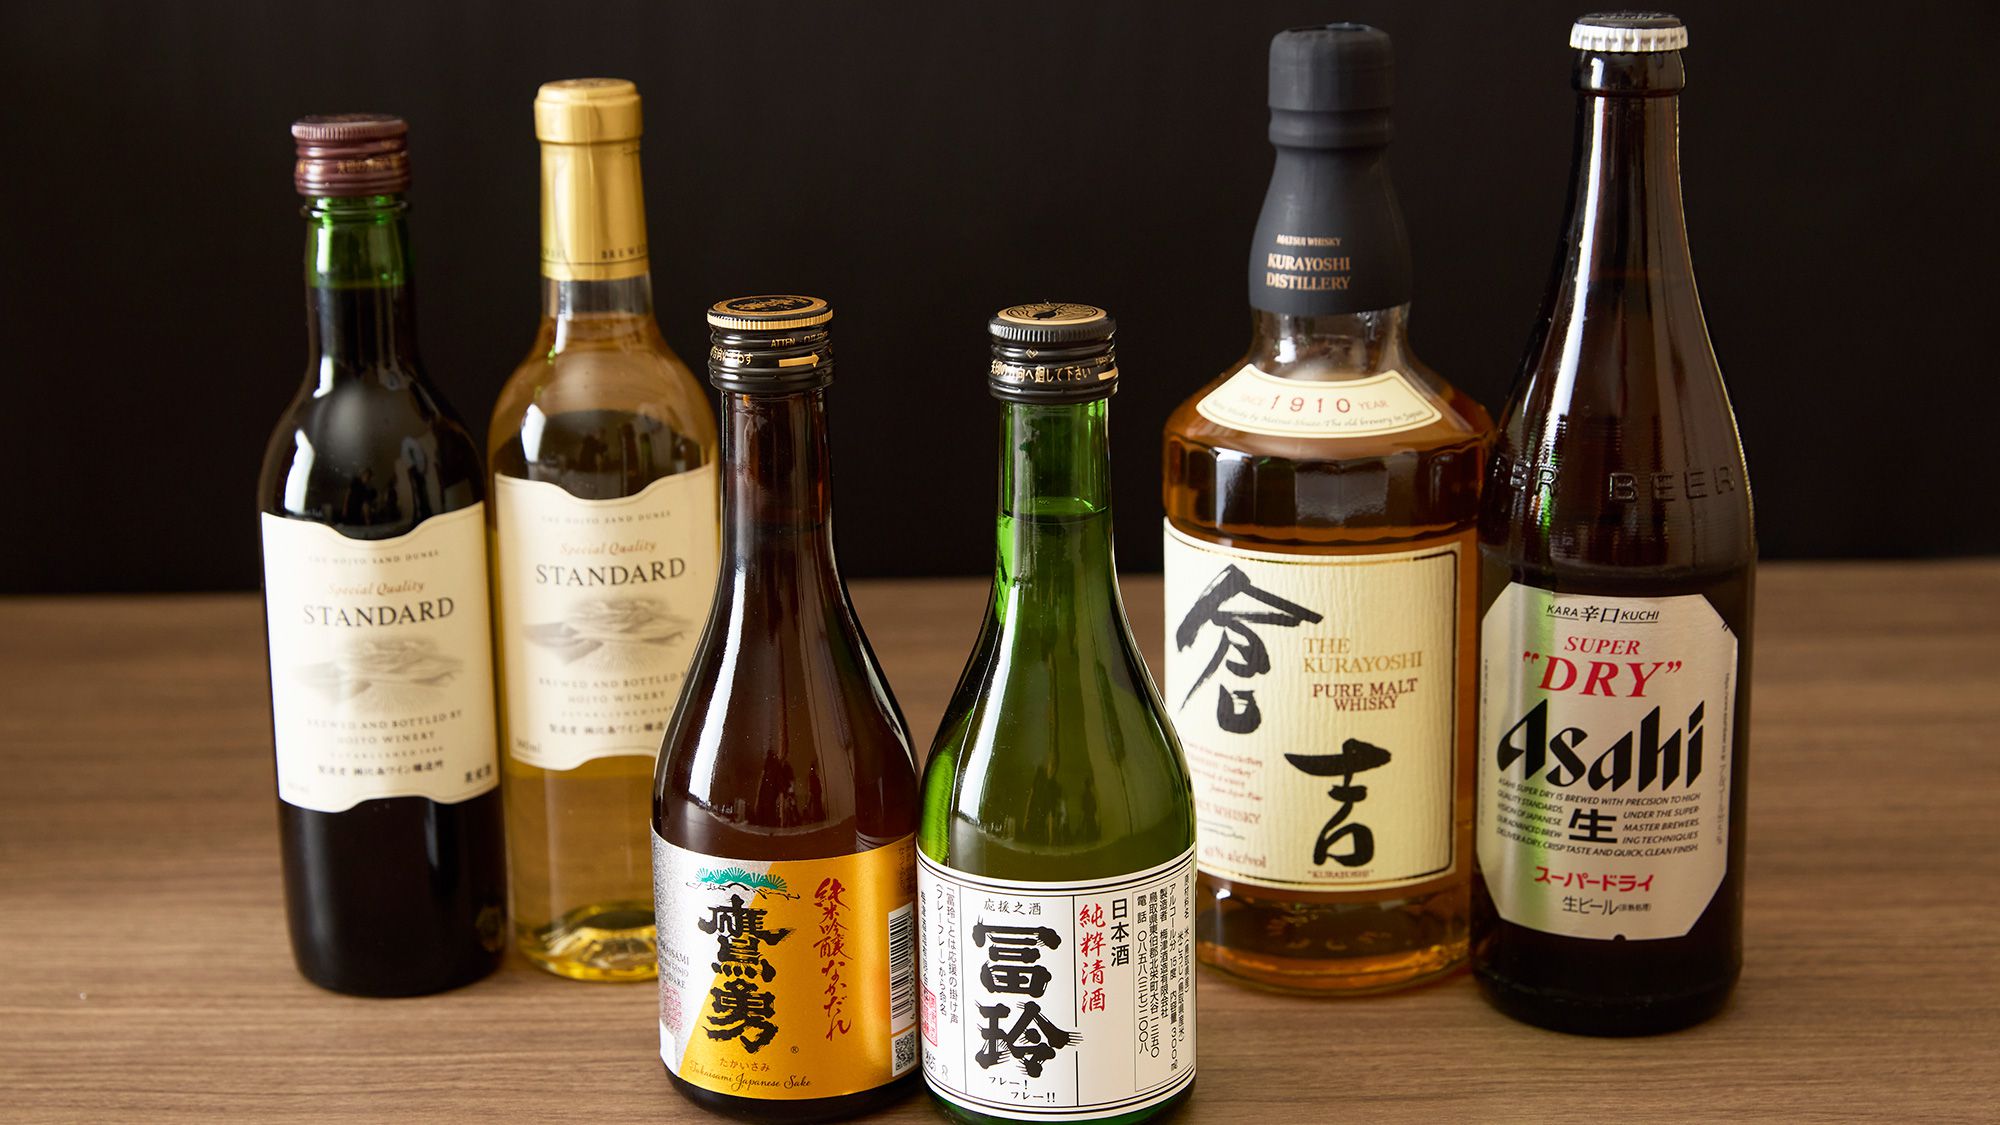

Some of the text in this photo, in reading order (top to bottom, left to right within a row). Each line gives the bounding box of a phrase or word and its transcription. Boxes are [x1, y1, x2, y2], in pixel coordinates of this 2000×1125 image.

[1307, 236, 1341, 247] WHISKY
[1267, 253, 1350, 272] KURAYOSHI
[1266, 272, 1351, 290] DISTILLERY
[1358, 400, 1389, 411] YEAR
[1609, 465, 1735, 501] BEER
[560, 539, 657, 556] Special Quality
[535, 557, 686, 586] STANDARD
[376, 579, 425, 597] Quality
[303, 597, 454, 627] STANDARD
[1546, 604, 1660, 623] KARA 辛口 KUCHI
[1303, 638, 1350, 654] THE
[1564, 636, 1641, 655] SUPER
[1304, 651, 1423, 673] KURAYOSHI
[592, 680, 618, 689] AND
[623, 671, 679, 687] BOTTLED
[1313, 678, 1418, 697] PURE MALT
[614, 690, 665, 703] WINERY
[1334, 694, 1399, 712] WHISKY
[361, 720, 388, 729] AND
[392, 711, 447, 728] BOTTLED
[449, 709, 462, 719] BY
[382, 730, 435, 744] WINERY
[1496, 698, 1705, 793] Asahi
[1517, 784, 1538, 795] SUPER
[1539, 789, 1555, 798] DRY
[1565, 794, 1599, 805] BREWED
[1601, 797, 1624, 806] WITH
[1626, 796, 1670, 806] PRECISION
[1671, 795, 1681, 803] TO
[1682, 792, 1701, 802] HIGH
[1526, 813, 1562, 826] JAPANESE
[1623, 811, 1654, 819] UNDER
[1656, 809, 1673, 818] THE
[1568, 808, 1618, 844] 生
[1623, 823, 1660, 832] MASTER
[1623, 830, 1699, 844] ING TECHNIQUES
[1543, 841, 1565, 851] CRISP
[1566, 845, 1592, 856] TASTE
[1593, 848, 1613, 856] AND
[1645, 847, 1672, 857] CLEAN
[1535, 865, 1654, 892] スーパードライ
[984, 898, 1042, 916] 応援之酒
[1562, 895, 1619, 915] 生ビール
[1111, 897, 1130, 967] 日本酒
[720, 1057, 770, 1072] たかいさみ
[731, 1072, 780, 1092] Japanese
[784, 1074, 813, 1089] Sake
